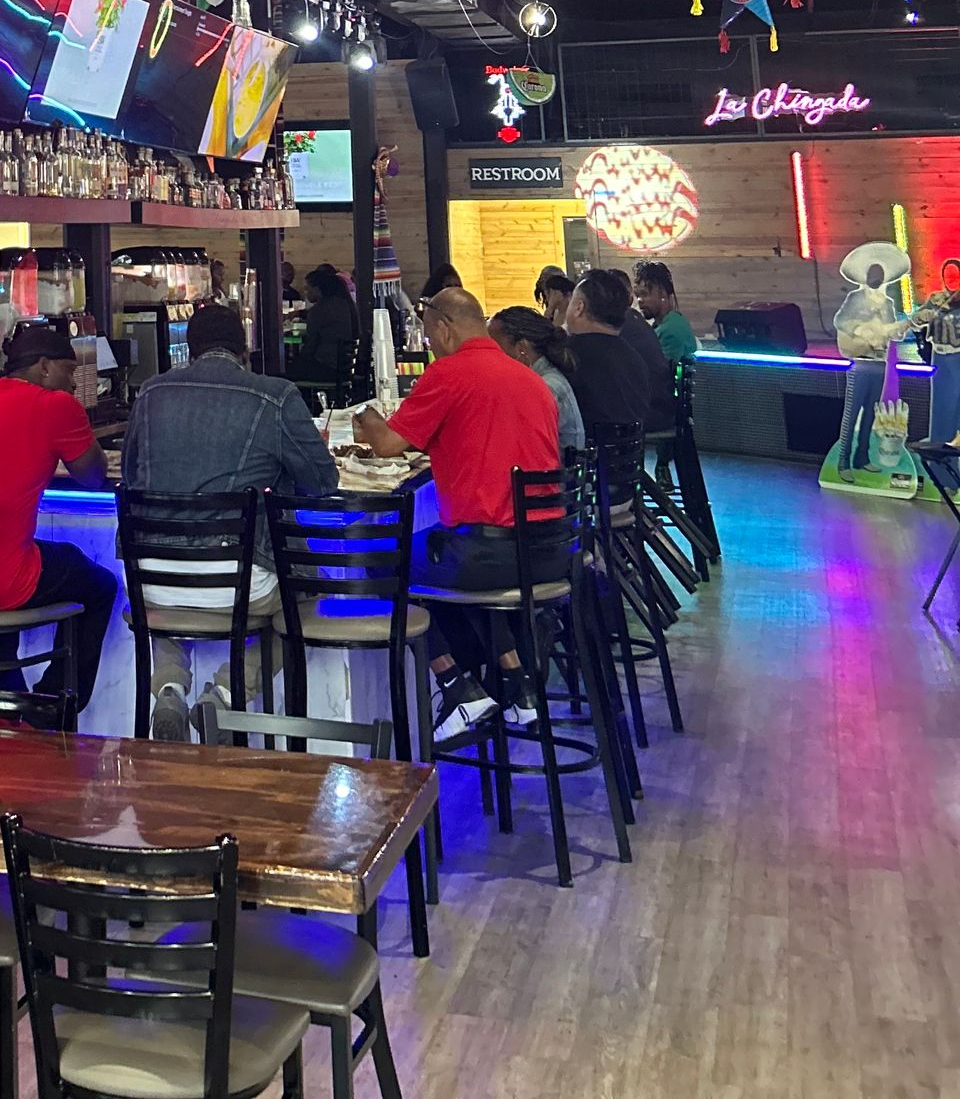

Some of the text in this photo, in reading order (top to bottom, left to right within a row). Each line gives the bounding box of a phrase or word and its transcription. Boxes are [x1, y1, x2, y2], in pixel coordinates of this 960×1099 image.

[521, 82, 547, 93] Corona
[704, 83, 870, 126] La Chingada
[472, 167, 560, 181] RESTROOM
